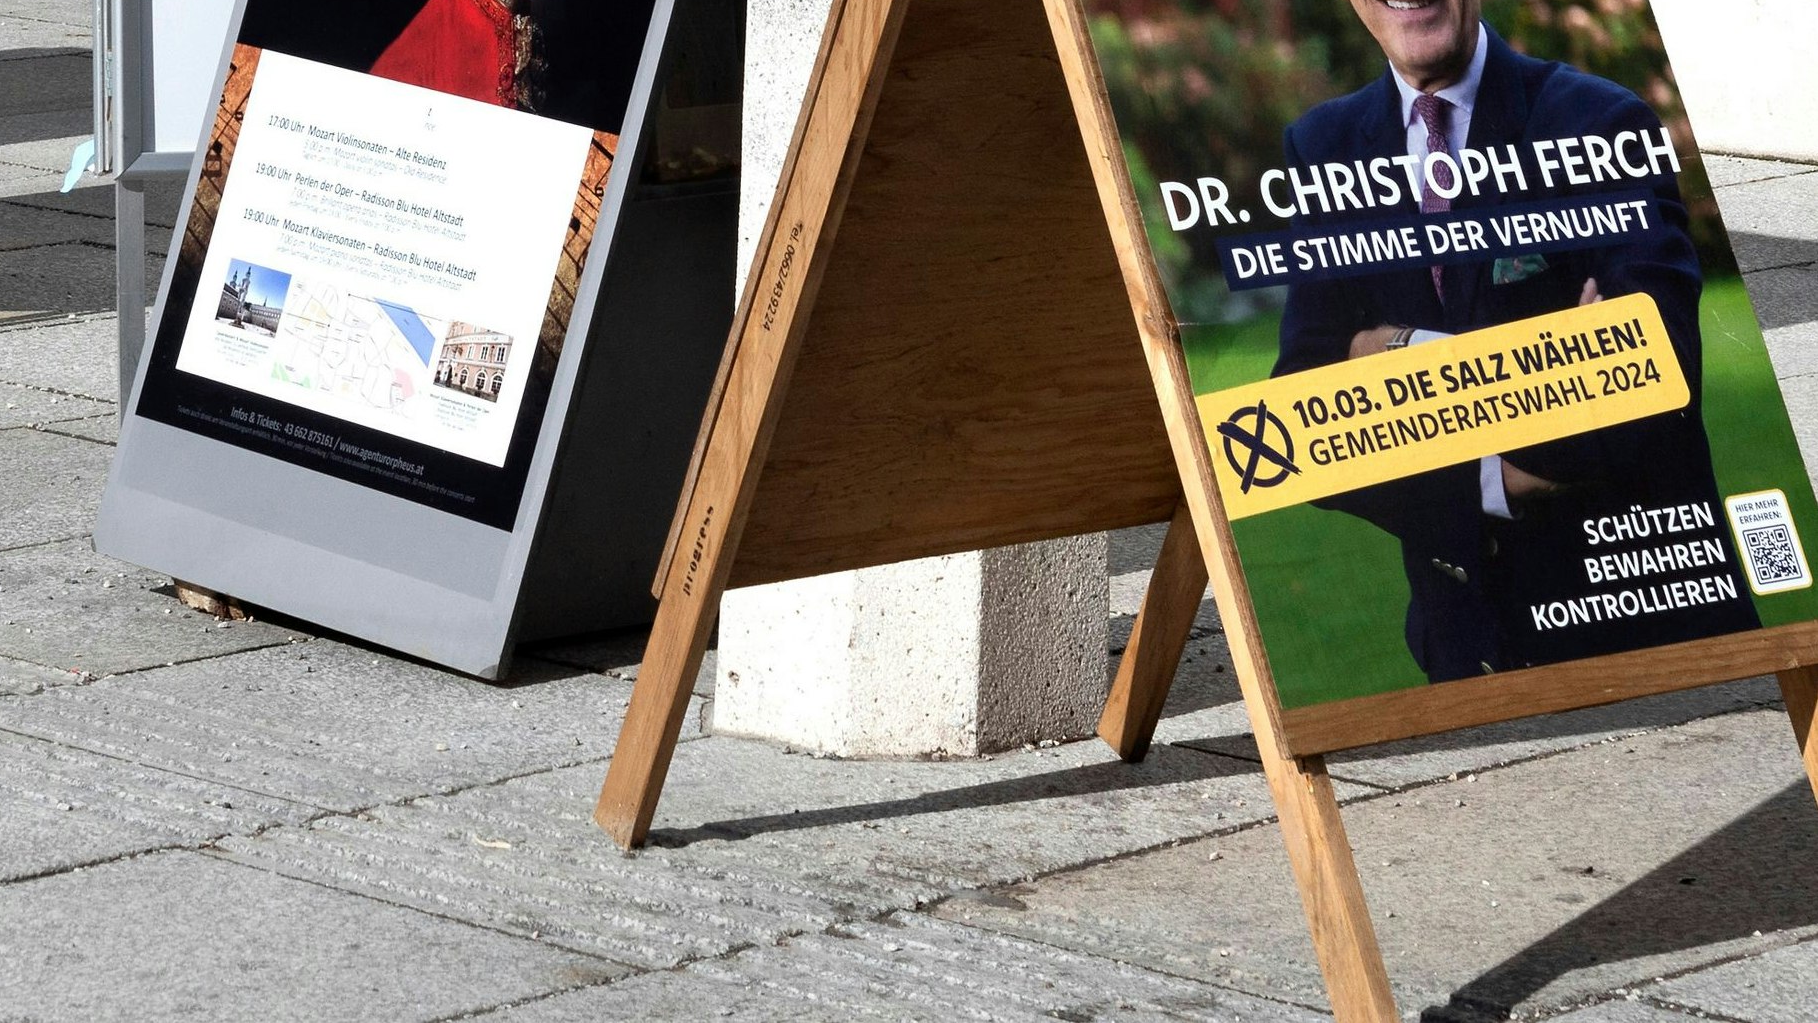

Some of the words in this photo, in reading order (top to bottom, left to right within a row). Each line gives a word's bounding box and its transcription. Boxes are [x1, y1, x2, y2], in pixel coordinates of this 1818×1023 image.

[268, 114, 290, 130] 17:00
[290, 120, 305, 133] Uhr
[308, 125, 335, 142] Mozart
[337, 132, 388, 155] Violinsonaten
[395, 147, 411, 161] Alte
[412, 151, 447, 170] Residenz
[255, 162, 277, 178] 19:00
[278, 168, 292, 181] Uhr
[294, 172, 319, 188] Perlen
[320, 179, 333, 192] der
[334, 183, 354, 197] Oper
[361, 190, 395, 209] Radisson
[396, 199, 409, 212] Blu
[410, 202, 432, 218] Hotel
[433, 209, 464, 227] Altstadt
[1159, 176, 1250, 232] DR.
[1260, 143, 1528, 218] CHRISTOPH
[1536, 126, 1681, 187] FERCH
[243, 208, 264, 223] 19:00
[265, 214, 280, 227] Uhr
[282, 218, 310, 235] Mozart
[310, 226, 366, 250] Klaviersonaten
[373, 243, 408, 262] Radisson
[408, 252, 422, 266] Blu
[422, 256, 445, 272] Hotel
[445, 263, 477, 281] Altstadt
[790, 220, 803, 243] Tel.
[1231, 240, 1288, 279] DIE
[1292, 225, 1422, 271] STIMME
[1426, 219, 1484, 256] DER
[1485, 199, 1650, 248] VERNUNFT
[1292, 384, 1383, 429] 10.03.
[1386, 369, 1436, 408] DIE
[1443, 351, 1510, 394] SALZ
[1510, 316, 1648, 376] WÄHLEN!
[230, 406, 248, 421] Infos
[248, 411, 256, 424] &
[256, 414, 282, 432] Tickets:
[294, 426, 308, 439] 662
[307, 430, 334, 447] 875161
[339, 442, 424, 476] www.agenturorpheus.at
[1308, 374, 1596, 466] GEMEINDERATSWAHL
[1596, 357, 1662, 397] 2024
[1583, 501, 1715, 545] SCHÜTZEN
[1735, 502, 1754, 513] HIER
[1755, 498, 1779, 510] MEHR
[1738, 511, 1782, 524] ERFAHREN:
[683, 505, 714, 596] progress
[1583, 537, 1726, 584] BEWAHREN
[1530, 574, 1738, 631] KONTROLLIEREN
